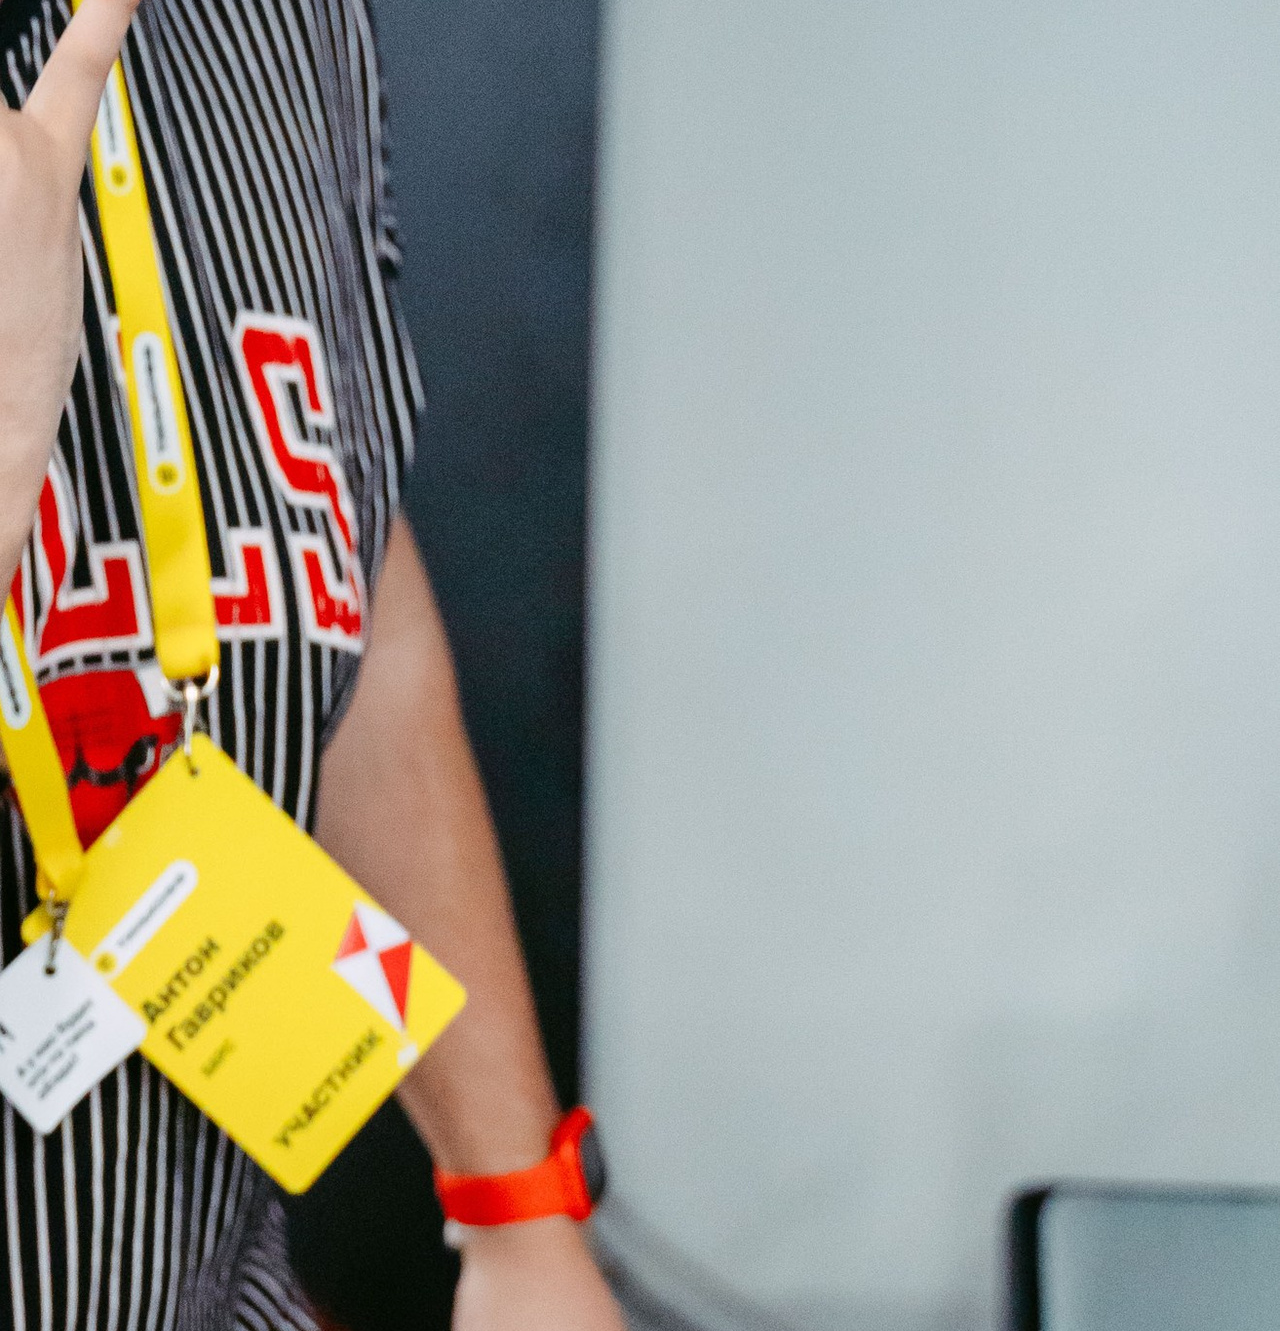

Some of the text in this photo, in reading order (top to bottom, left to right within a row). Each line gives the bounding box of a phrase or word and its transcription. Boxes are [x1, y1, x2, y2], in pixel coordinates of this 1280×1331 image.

[139, 936, 221, 1027] Антон
[164, 919, 286, 1052] Гавриков
[273, 1029, 382, 1149] УЧАСТНИК
